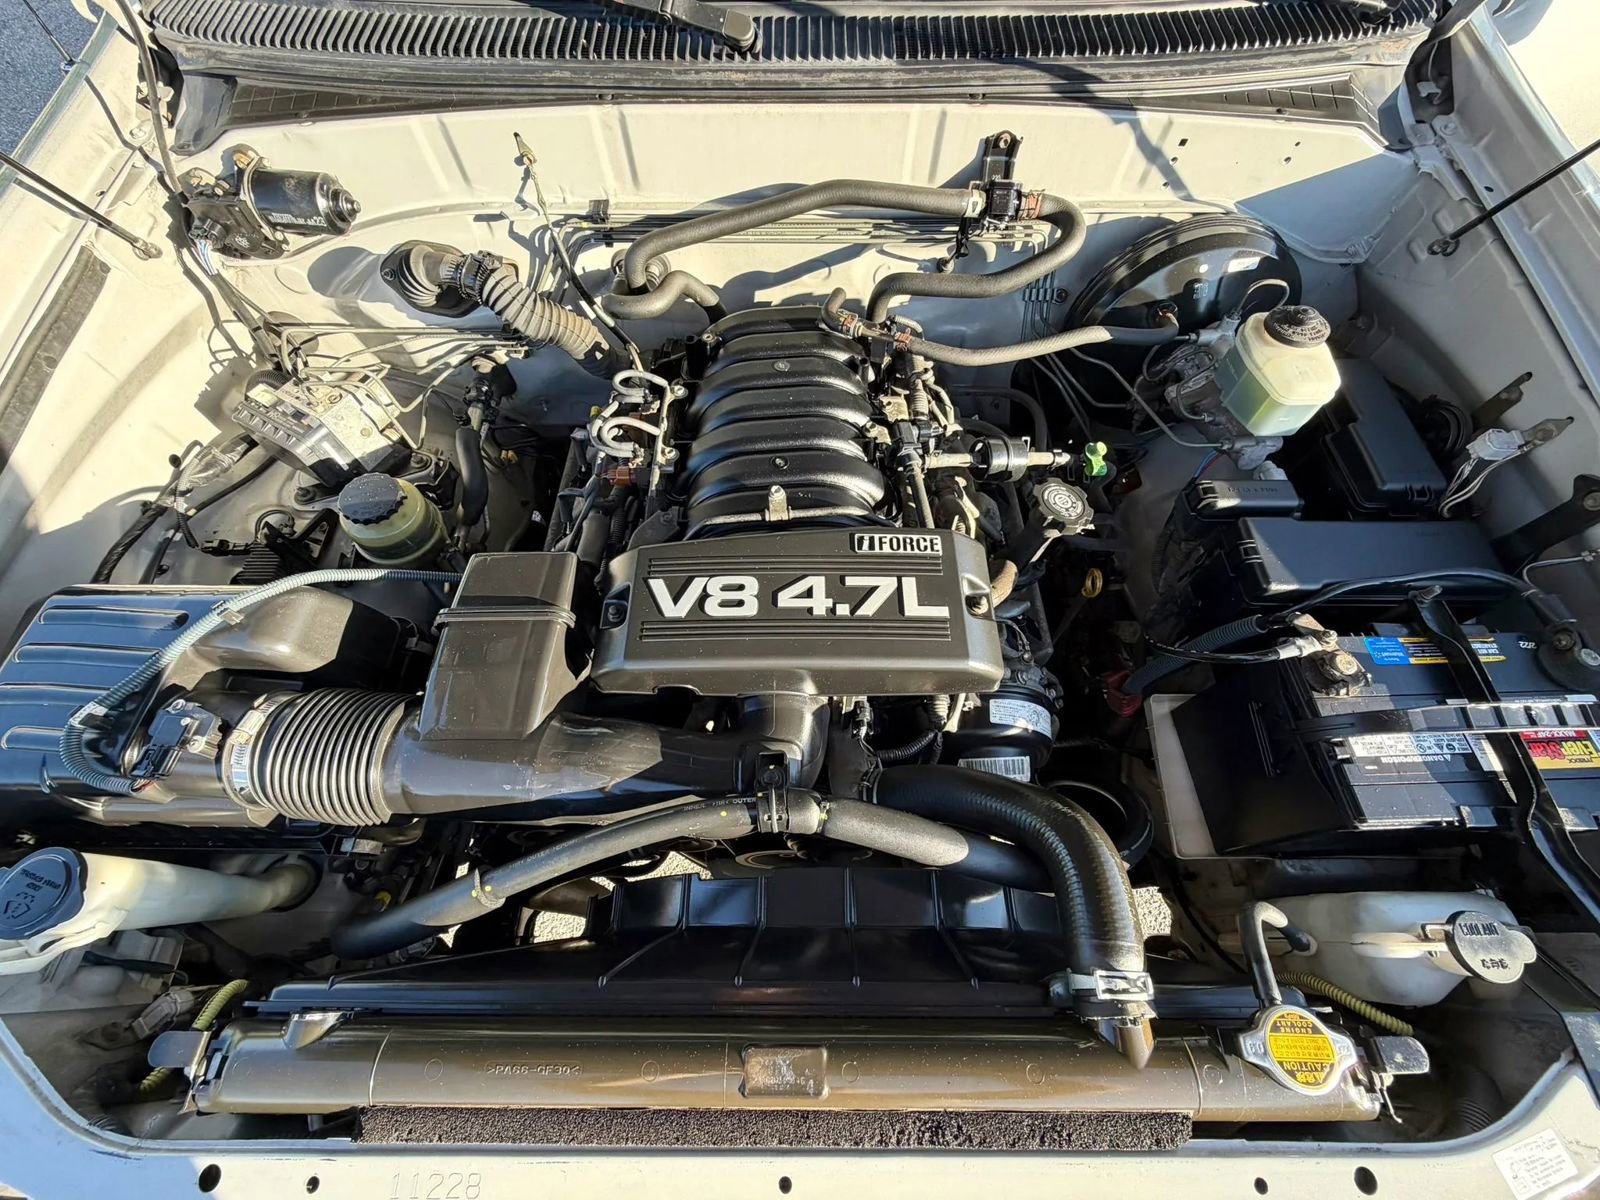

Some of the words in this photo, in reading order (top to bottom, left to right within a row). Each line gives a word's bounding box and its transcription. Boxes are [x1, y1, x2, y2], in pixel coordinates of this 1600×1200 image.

[648, 575, 759, 618] V8
[777, 575, 950, 618] 4.7L
[1276, 1020, 1313, 1028] COOLANT
[1284, 1061, 1330, 1072] CAUTION
[389, 1172, 482, 1200] 11228
